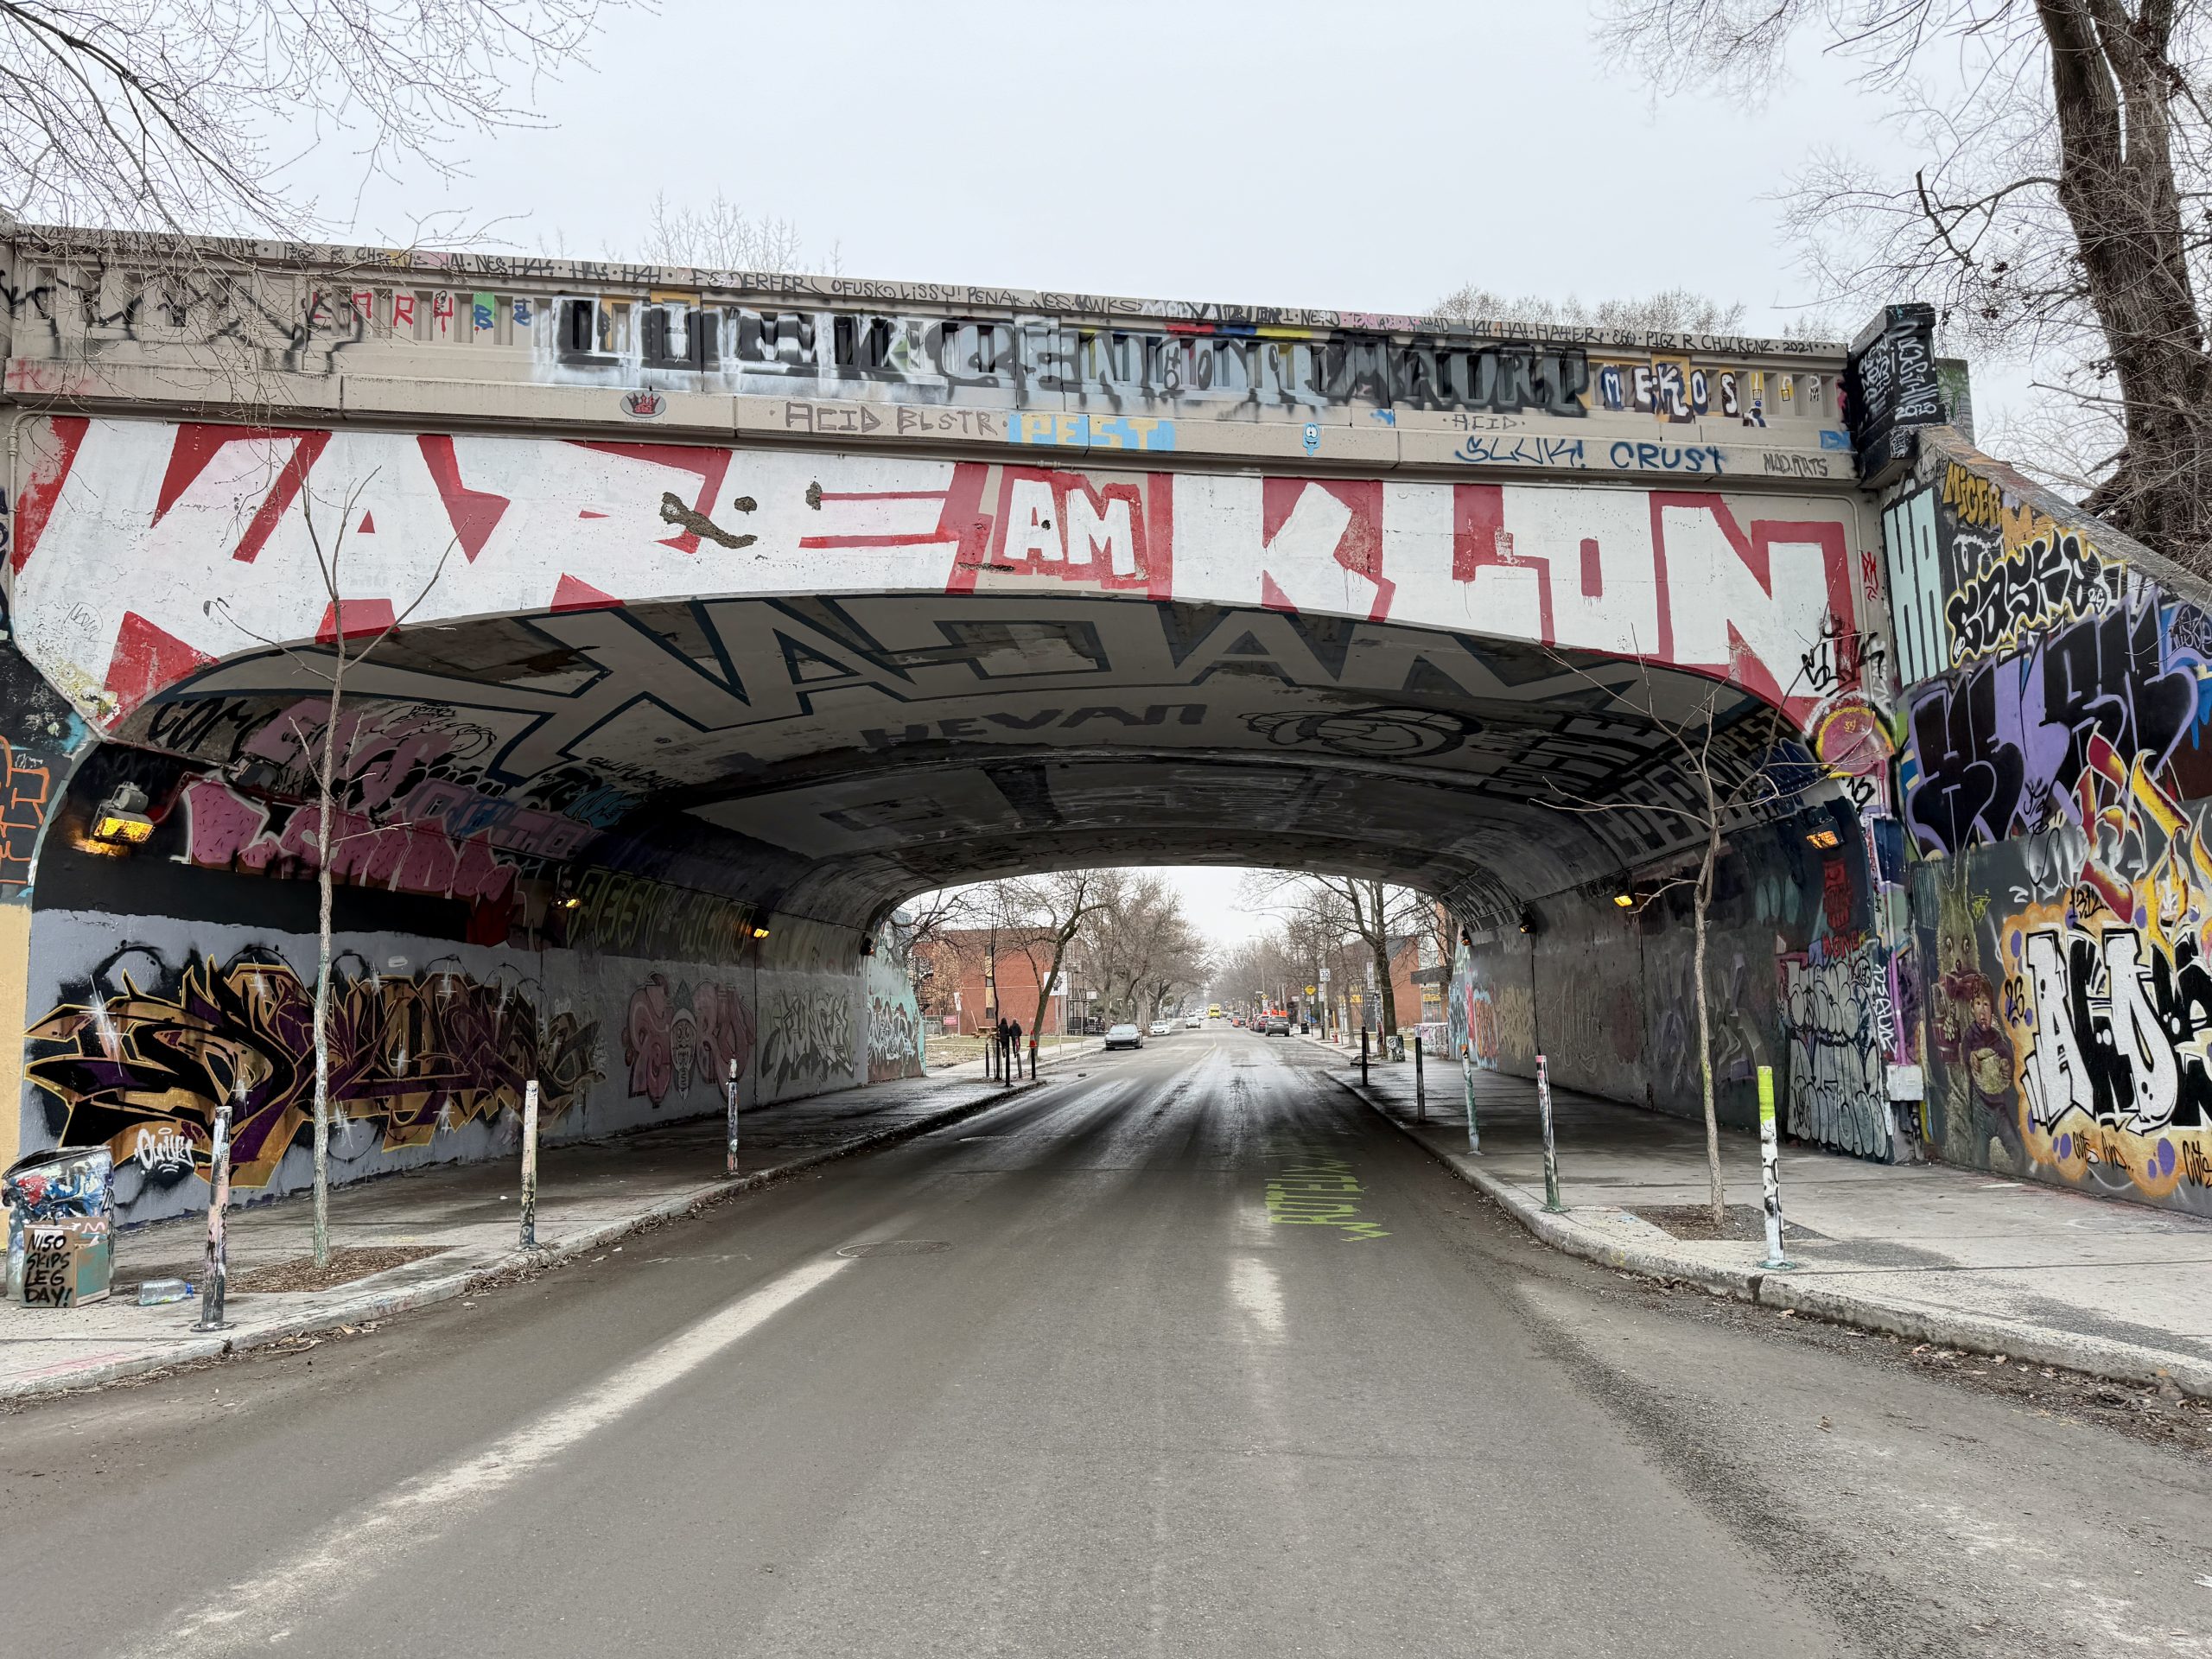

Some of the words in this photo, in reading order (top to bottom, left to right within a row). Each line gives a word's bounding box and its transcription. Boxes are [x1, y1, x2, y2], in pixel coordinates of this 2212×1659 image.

[785, 402, 880, 432] ACID
[1022, 416, 1158, 450] PEST
[1007, 478, 1136, 577] AM
[27, 1234, 67, 1251] NISO
[26, 1252, 71, 1271] SKIPS
[24, 1269, 65, 1287] LEG
[24, 1286, 73, 1307] DAY!
